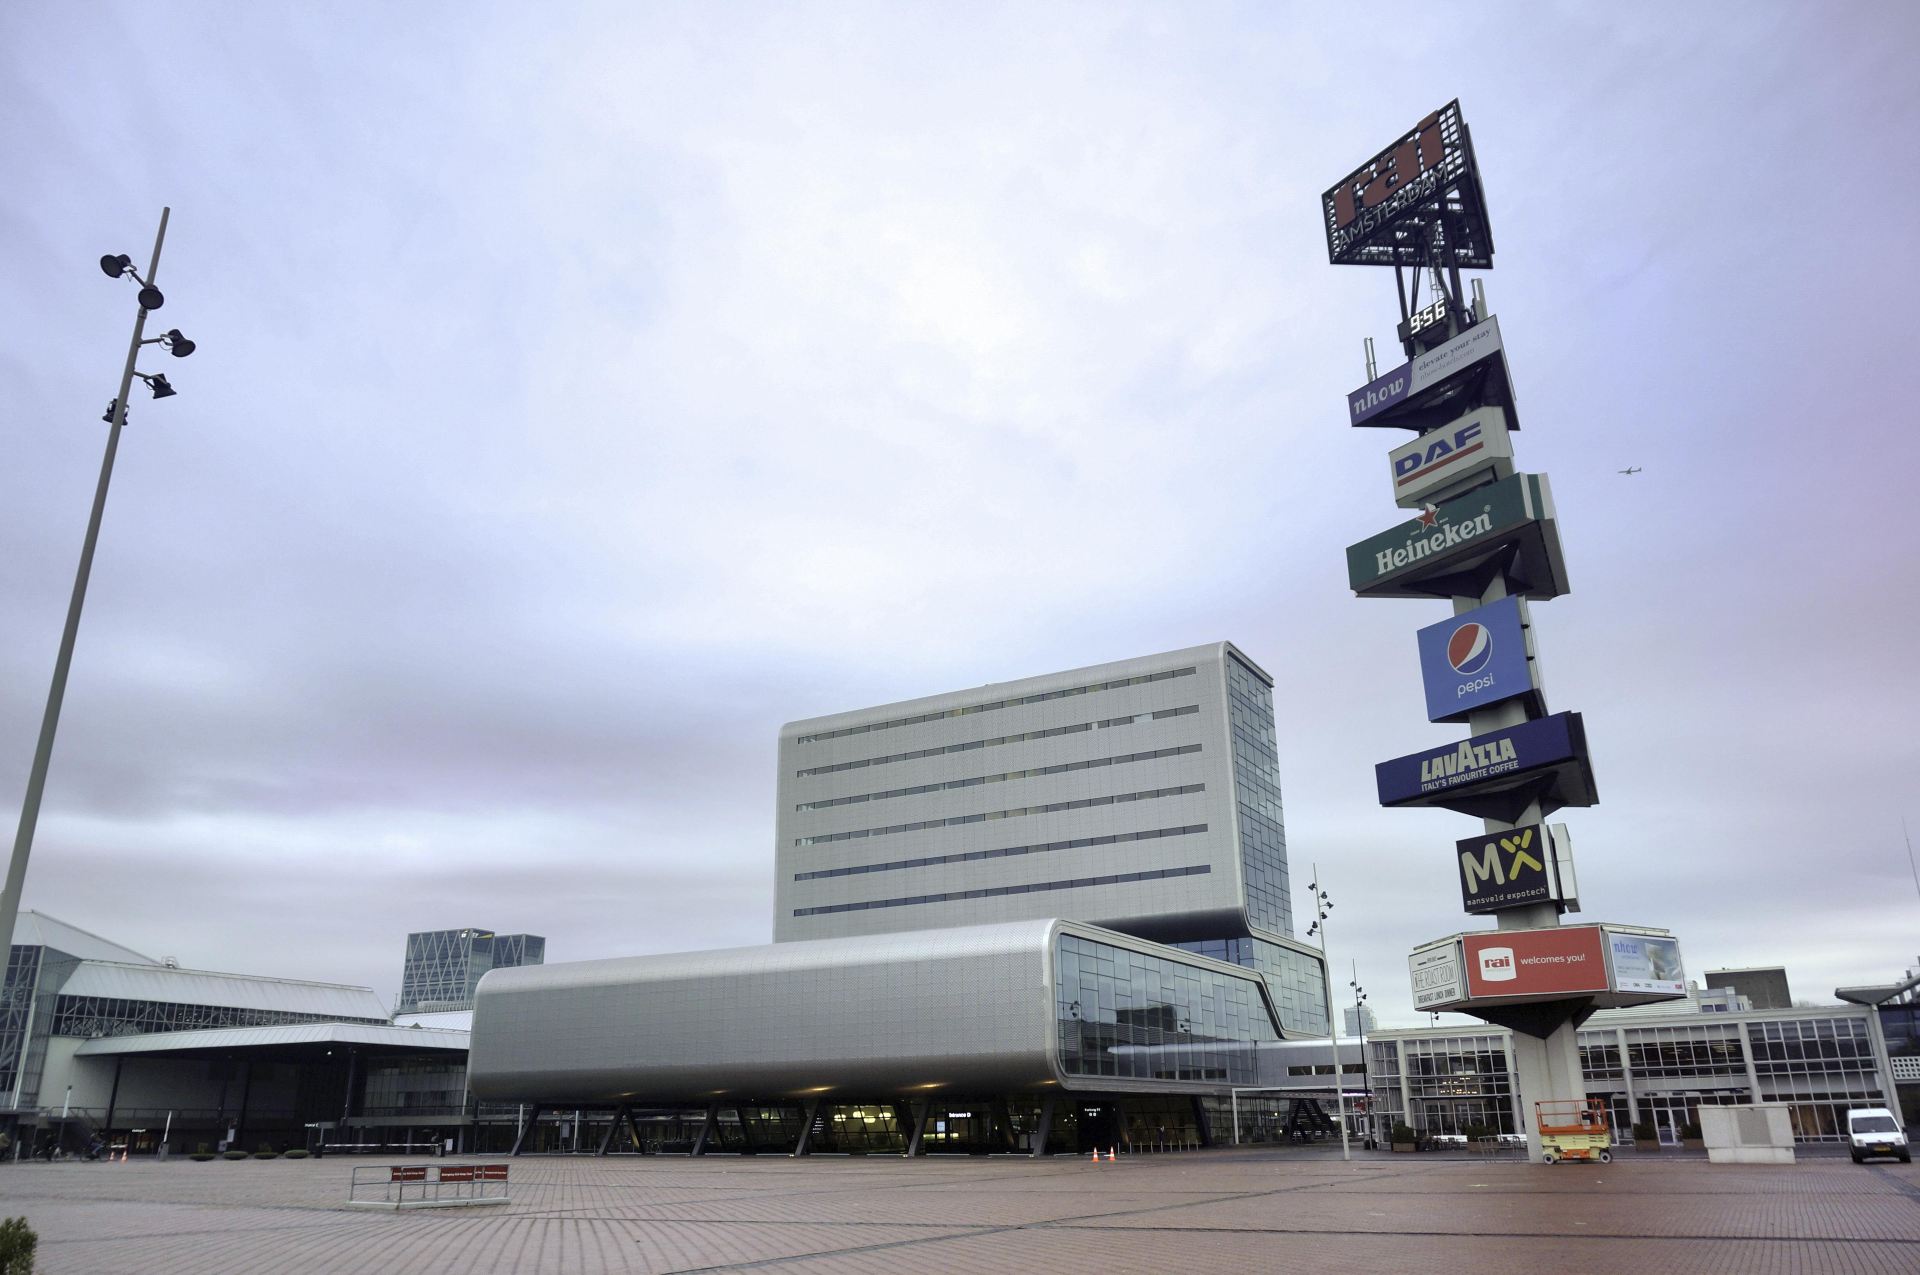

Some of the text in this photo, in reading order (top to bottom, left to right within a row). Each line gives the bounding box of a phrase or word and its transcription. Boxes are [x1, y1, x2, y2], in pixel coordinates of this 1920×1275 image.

[1338, 163, 1449, 249] AMSTERDAM
[1410, 300, 1446, 334] 9:56
[1418, 328, 1491, 371] elevate your stay
[1353, 377, 1404, 415] nhow
[1395, 421, 1482, 477] DAF
[1376, 514, 1493, 575] Heineken
[1457, 673, 1494, 698] pepsi
[1421, 738, 1517, 782] LAVAZZA
[1421, 760, 1519, 792] ITALY'S FAVOURITE COFFEE
[1467, 887, 1546, 906] mansveld expotech
[1484, 953, 1586, 968] rai welcomes you!
